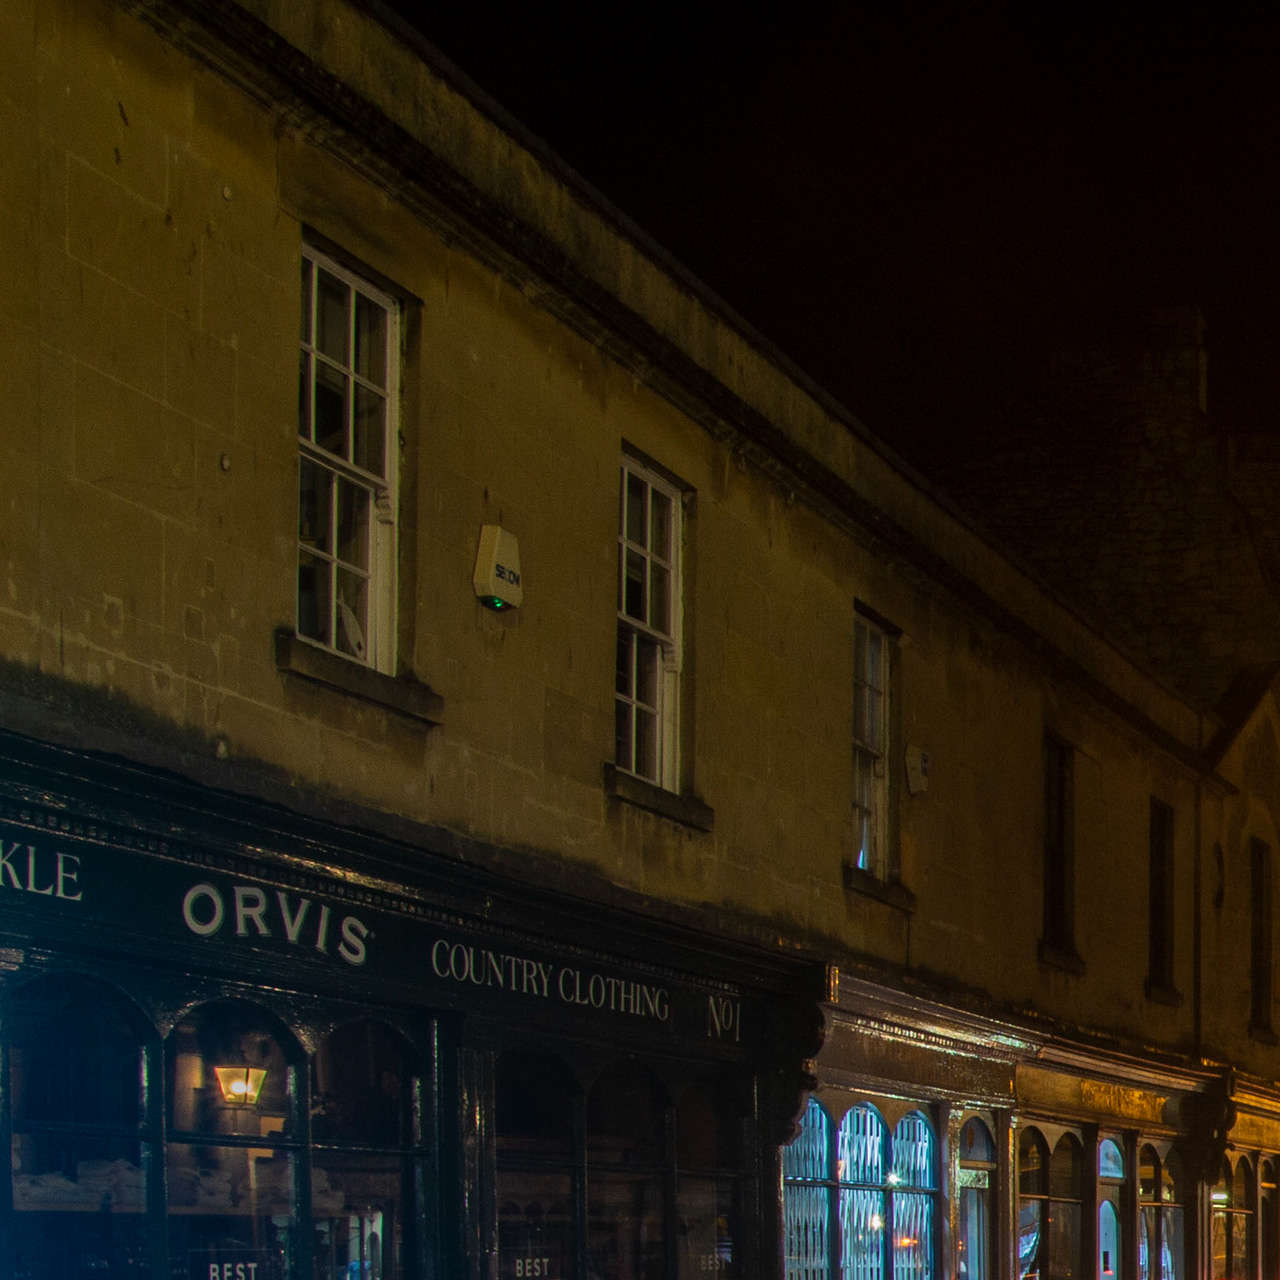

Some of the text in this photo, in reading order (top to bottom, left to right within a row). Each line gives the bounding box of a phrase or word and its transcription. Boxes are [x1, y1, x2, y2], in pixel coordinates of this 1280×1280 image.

[182, 883, 371, 966] ORVIS
[431, 939, 669, 1021] COUNTRY CLOTHING
[515, 1257, 549, 1278] BEST
[701, 1254, 727, 1271] BEST
